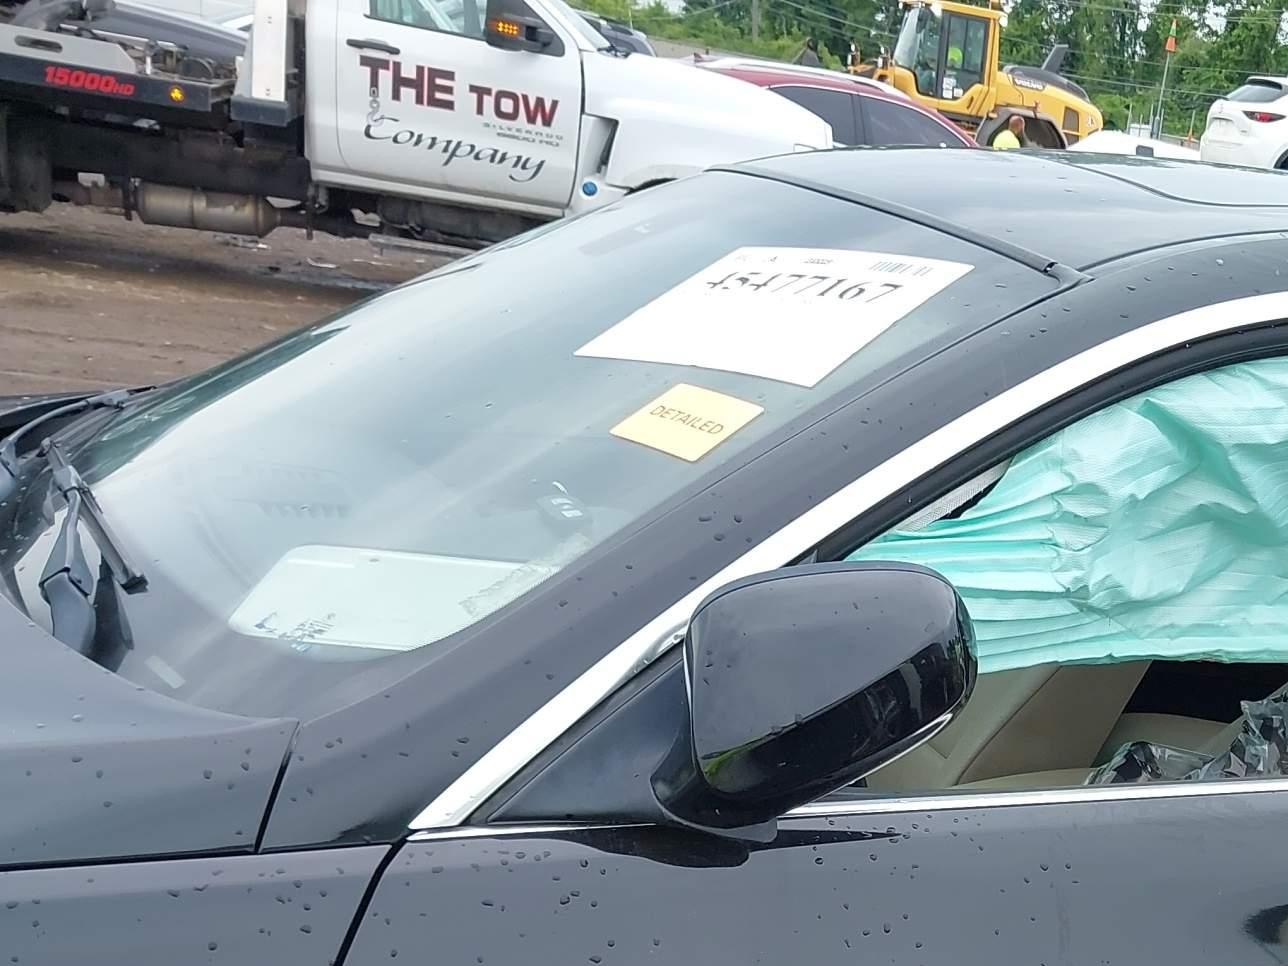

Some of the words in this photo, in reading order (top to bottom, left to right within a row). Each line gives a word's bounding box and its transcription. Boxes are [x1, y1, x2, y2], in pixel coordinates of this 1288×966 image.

[360, 54, 456, 112] THE
[469, 84, 560, 128] TOW
[364, 115, 546, 182] Company
[706, 272, 903, 303] 45477167
[650, 405, 724, 435] DETAILED
